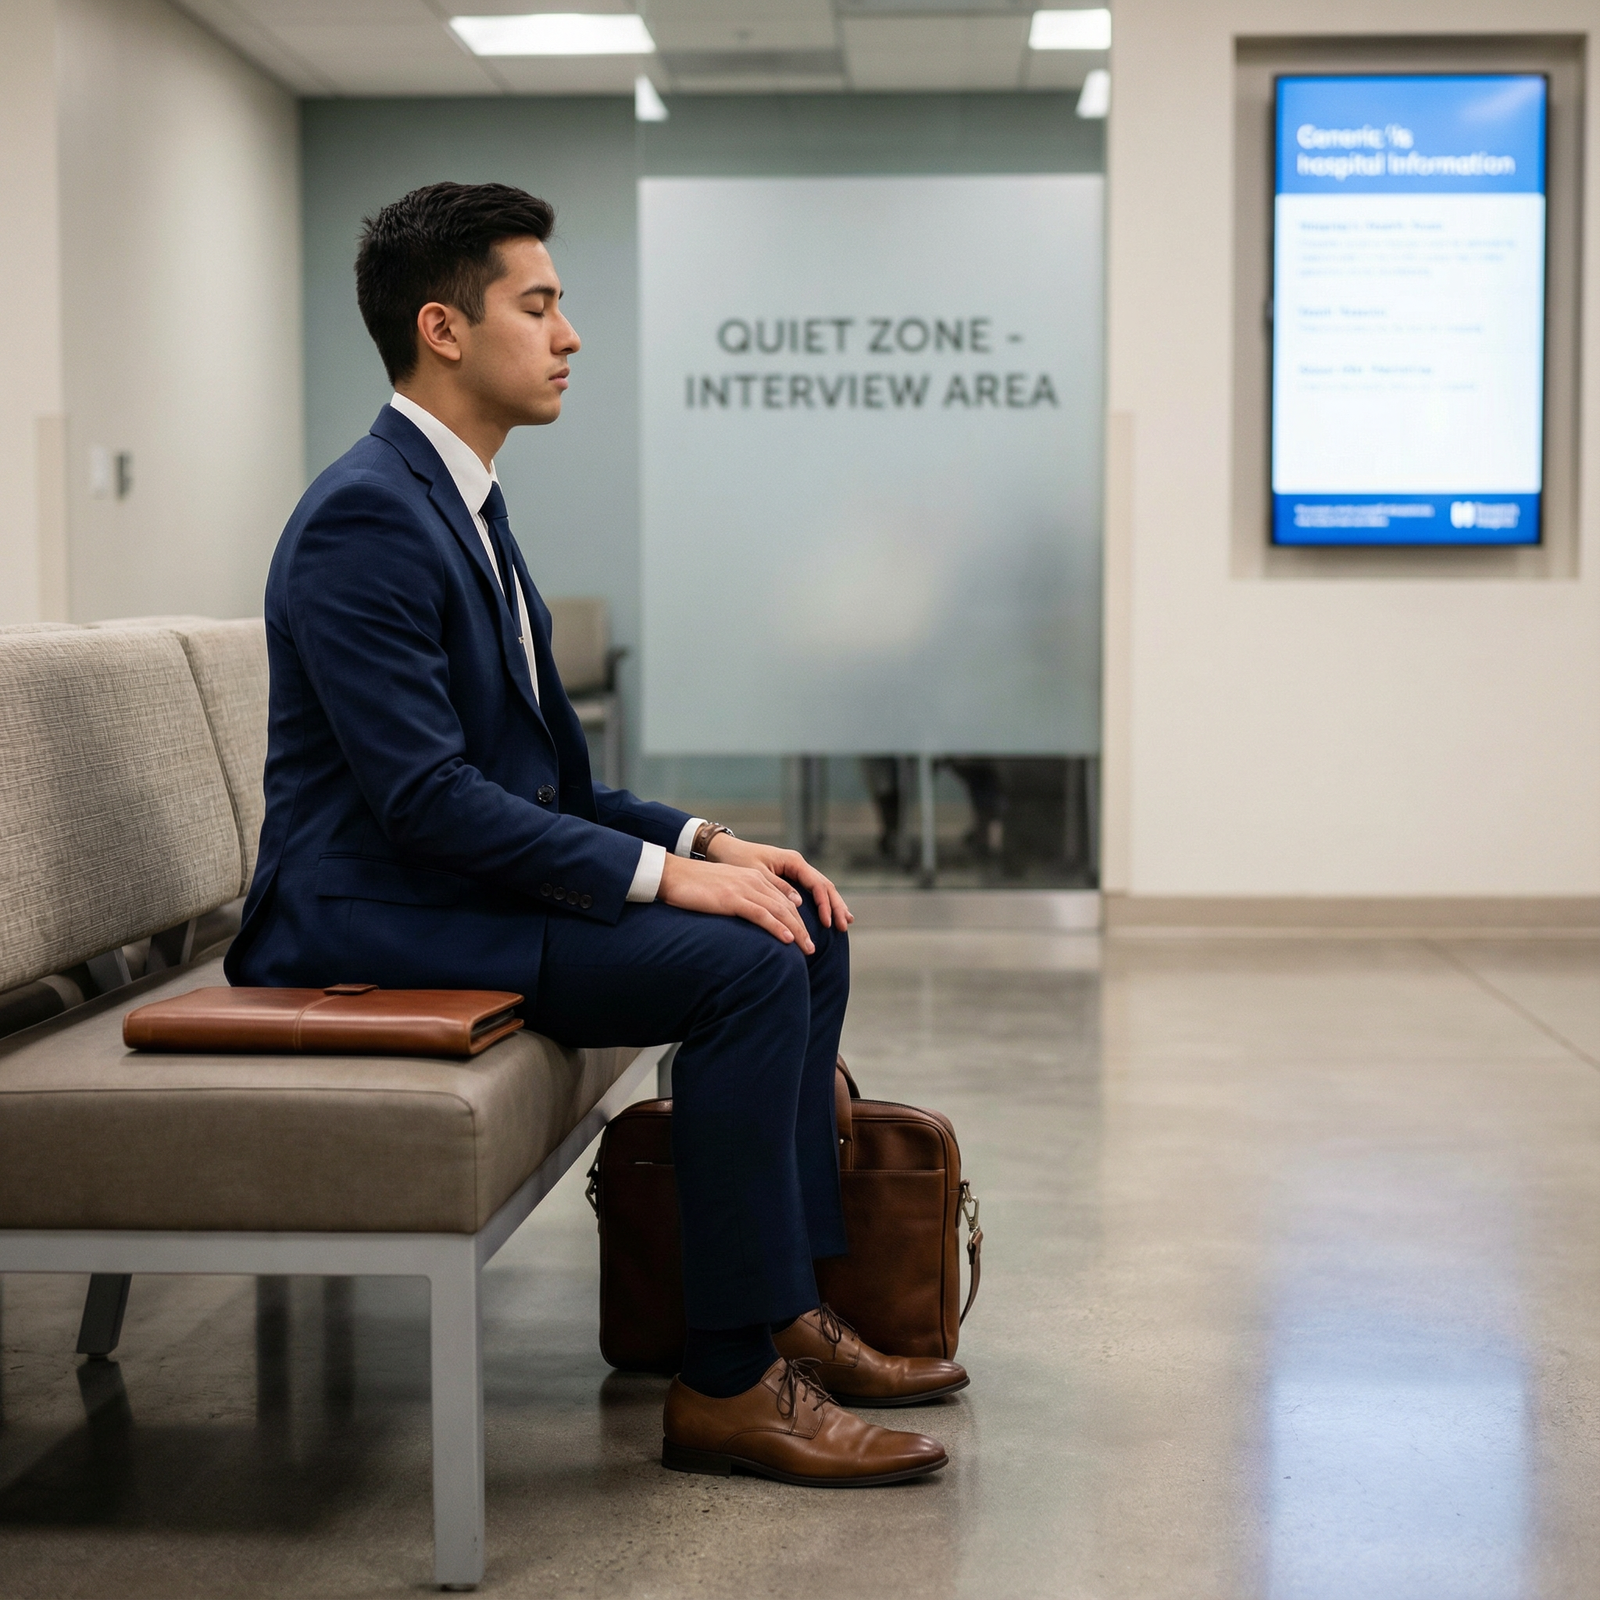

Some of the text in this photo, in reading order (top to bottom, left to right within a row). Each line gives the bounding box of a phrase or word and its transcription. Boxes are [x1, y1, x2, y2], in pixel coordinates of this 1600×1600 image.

[716, 317, 855, 355] QUIET
[868, 317, 991, 354] ZONE
[685, 372, 1060, 410] INTERVIEW AREA
